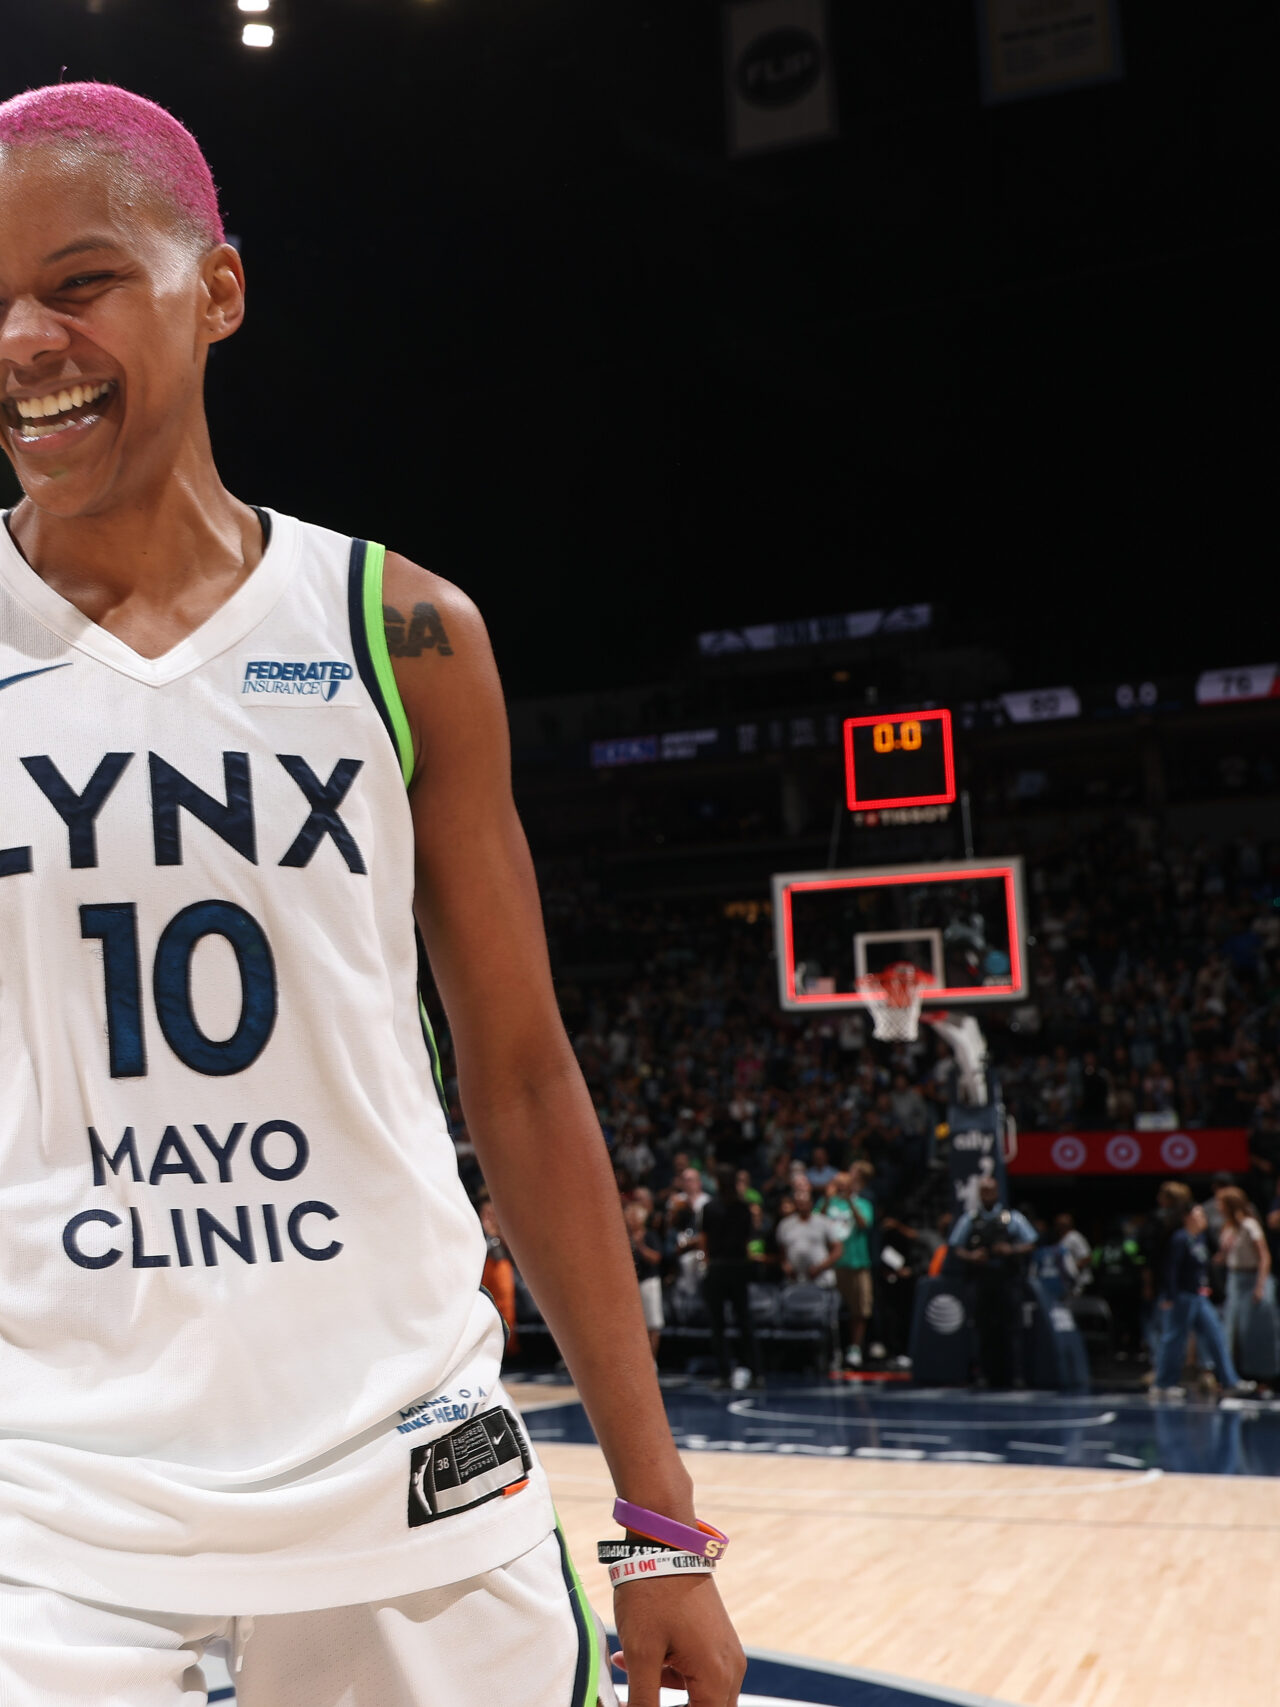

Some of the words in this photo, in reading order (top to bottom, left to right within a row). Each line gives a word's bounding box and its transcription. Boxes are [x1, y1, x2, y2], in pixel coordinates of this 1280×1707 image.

[245, 661, 354, 681] FEDERATED
[242, 680, 321, 695] INSURANCE
[872, 719, 922, 754] 0.0
[79, 898, 278, 1078] 10
[88, 1119, 311, 1187] MAYO
[62, 1200, 345, 1270] CLINIC
[396, 1413, 435, 1434] NIKE
[436, 1457, 450, 1471] 38
[624, 1563, 636, 1576] IT
[639, 1559, 657, 1573] DO
